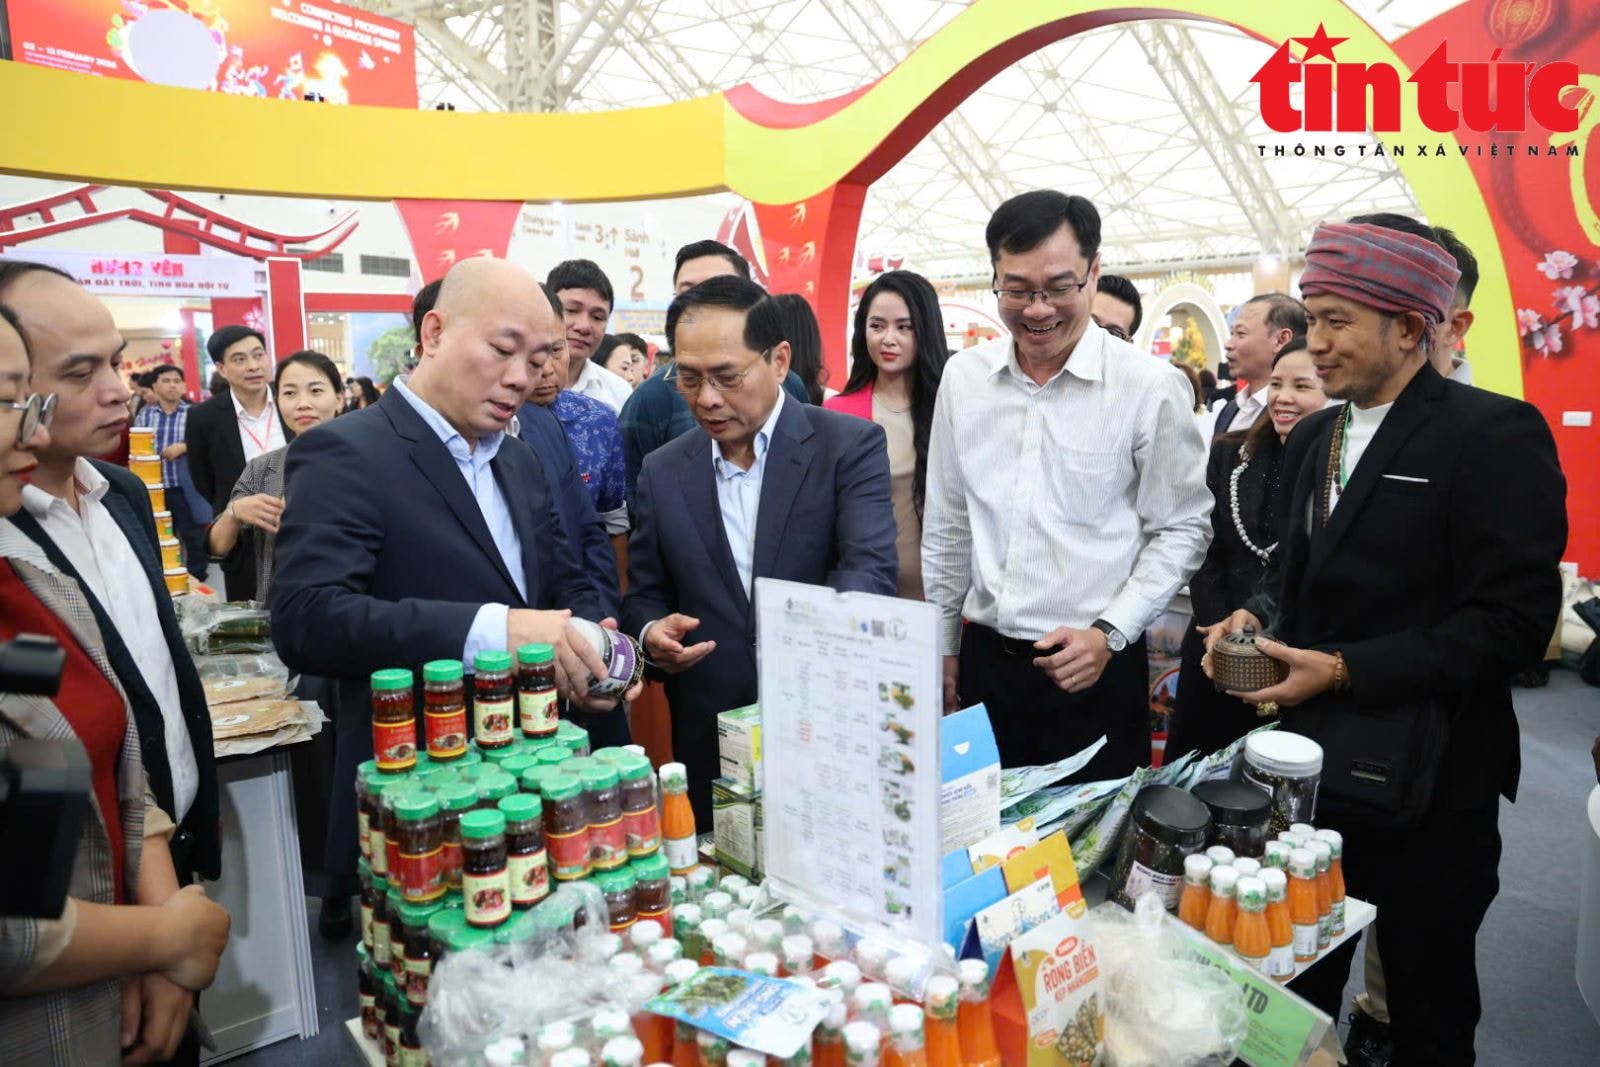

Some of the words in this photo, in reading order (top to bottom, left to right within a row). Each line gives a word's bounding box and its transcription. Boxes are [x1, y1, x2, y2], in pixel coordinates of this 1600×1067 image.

[151, 258, 185, 277] YÊN
[149, 279, 173, 288] TINH
[175, 280, 195, 289] HOA
[629, 264, 645, 299] 2
[1043, 960, 1072, 993] RONG
[1073, 940, 1097, 974] BIỂN
